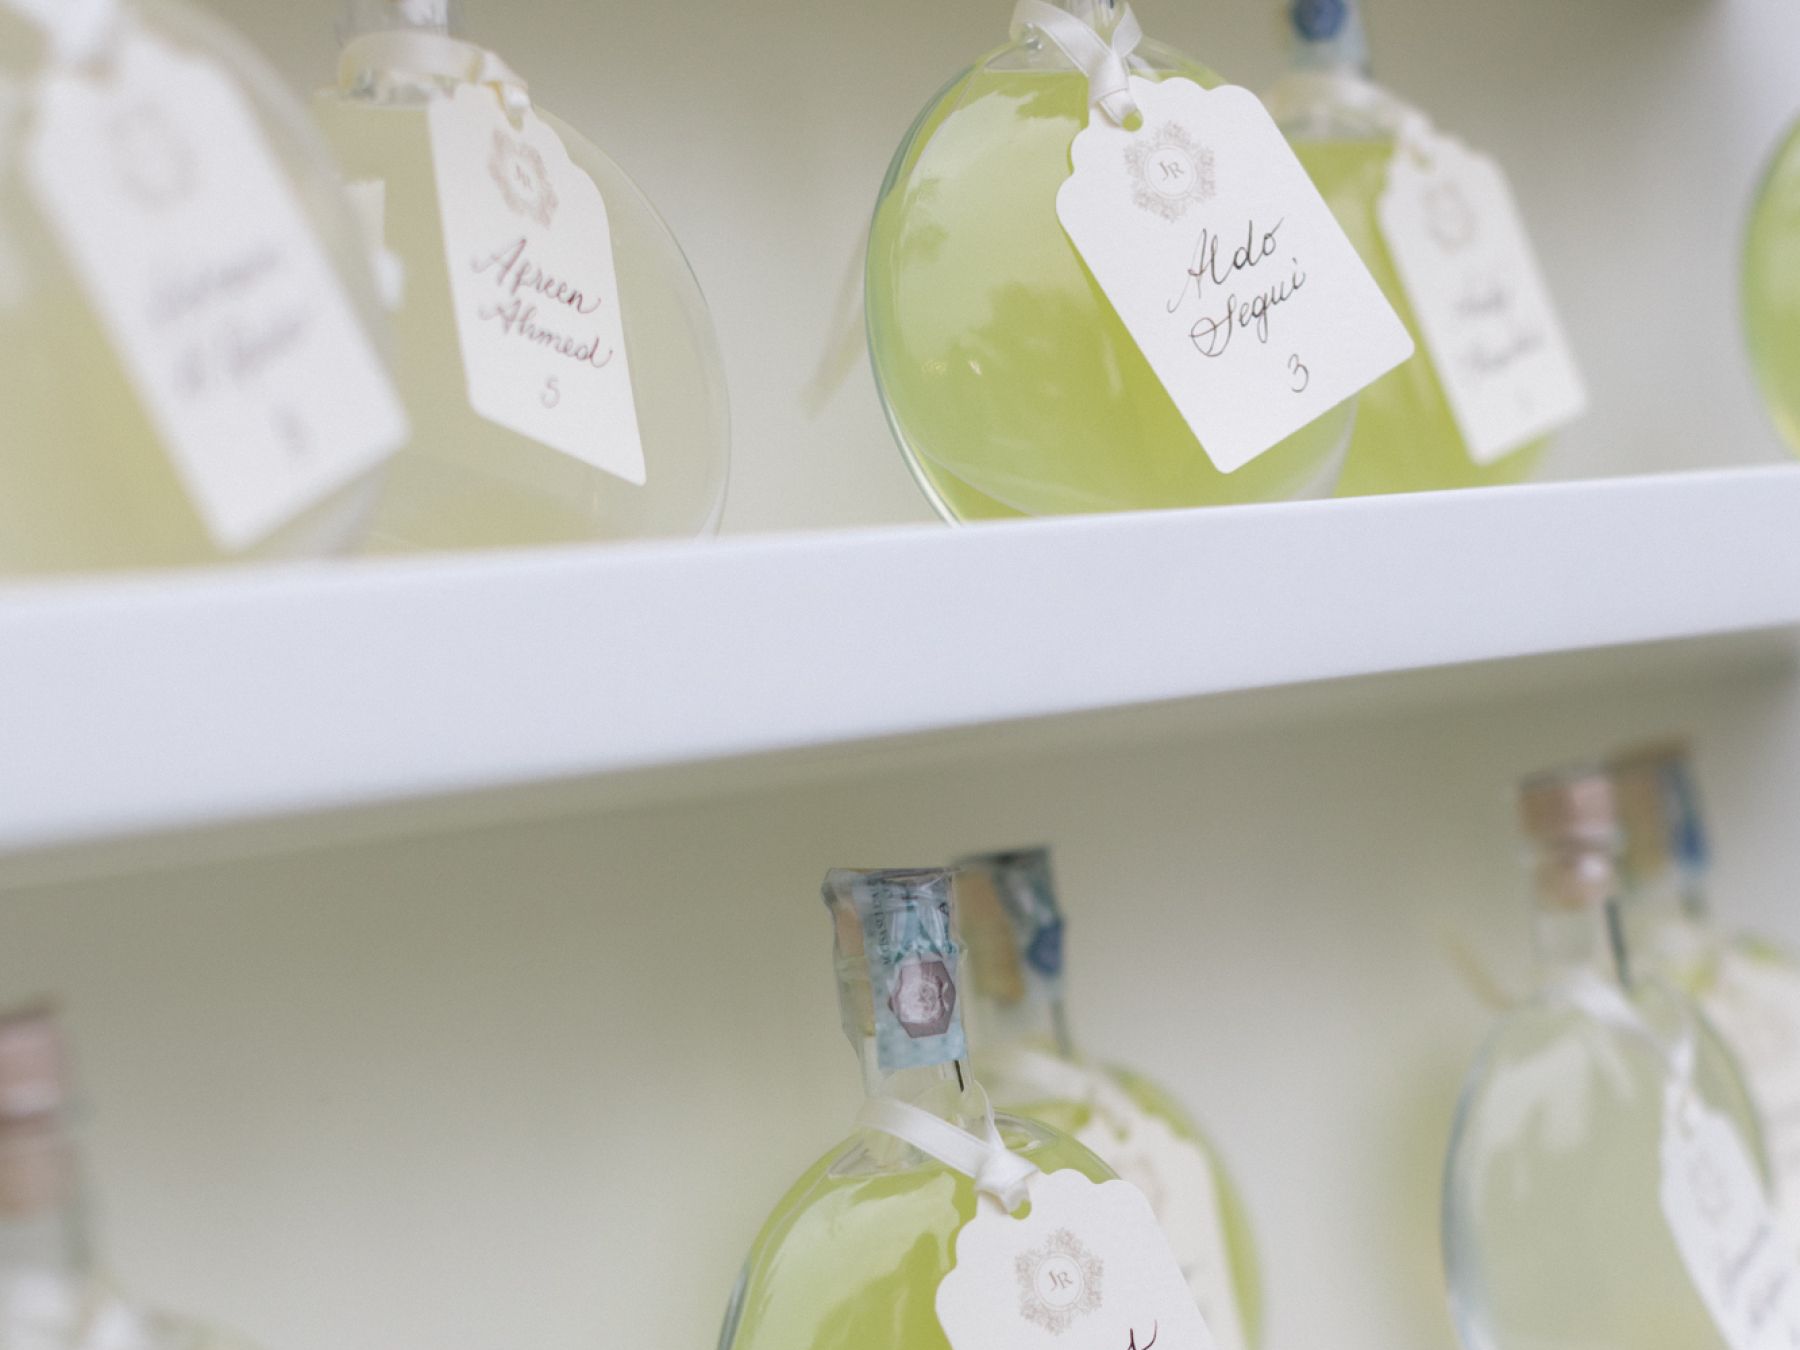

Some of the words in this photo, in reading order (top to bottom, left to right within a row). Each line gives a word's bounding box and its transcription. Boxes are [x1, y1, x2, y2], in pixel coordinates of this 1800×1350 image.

[1167, 217, 1285, 313] Aldo
[480, 299, 613, 369] Ahmed
[1287, 353, 1309, 393] 3
[1048, 1268, 1074, 1292] JR
